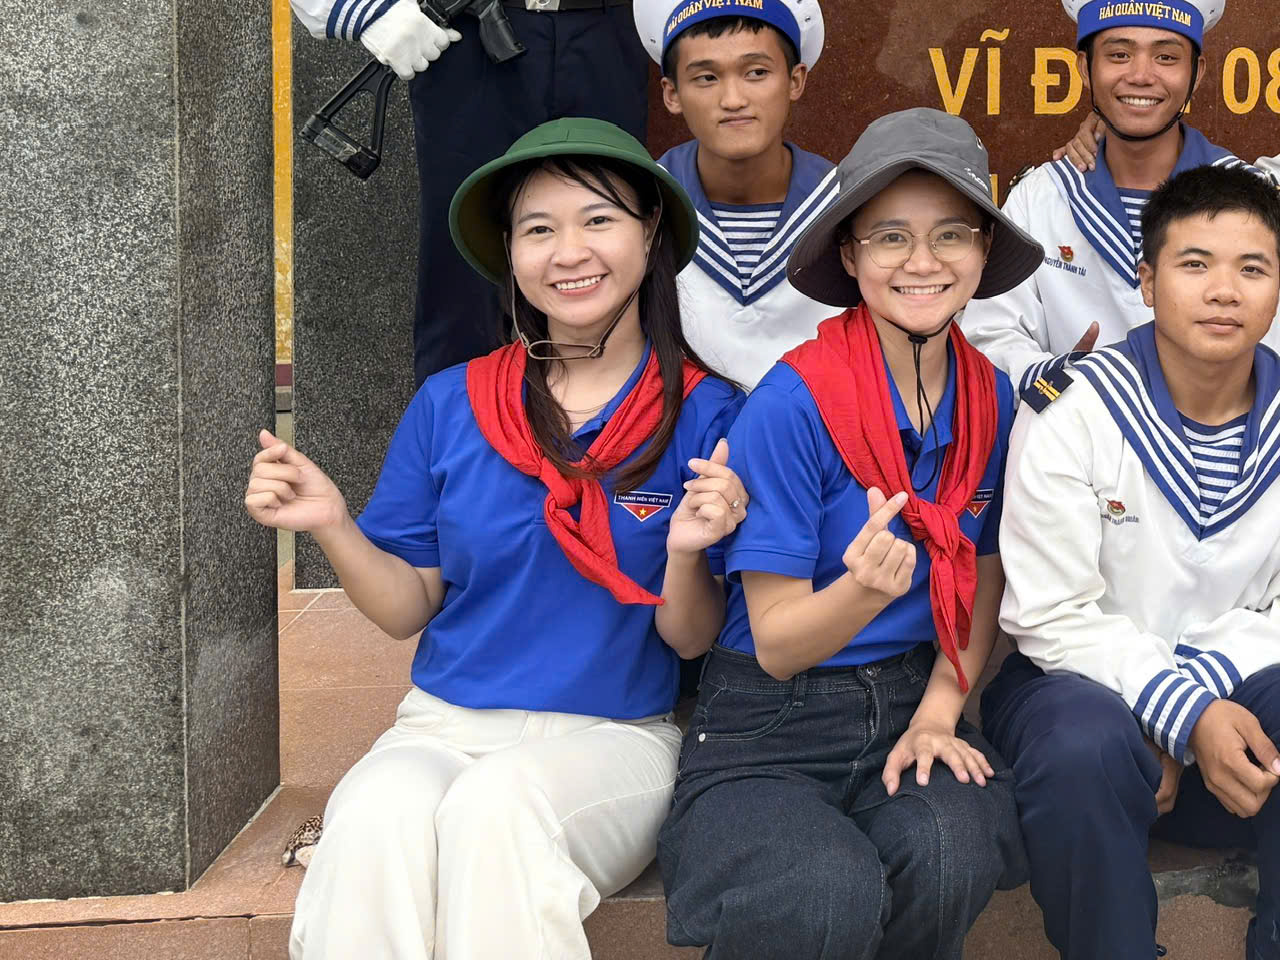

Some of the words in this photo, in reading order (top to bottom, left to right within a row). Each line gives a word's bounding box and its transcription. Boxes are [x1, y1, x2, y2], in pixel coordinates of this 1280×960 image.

[678, 1, 703, 23] QUÂN
[1099, 1, 1115, 20] HẢI
[1115, 0, 1145, 17] QUÂN
[1145, 1, 1172, 20] VIỆT
[1171, 8, 1192, 27] NAM
[927, 27, 1010, 116] VĨ
